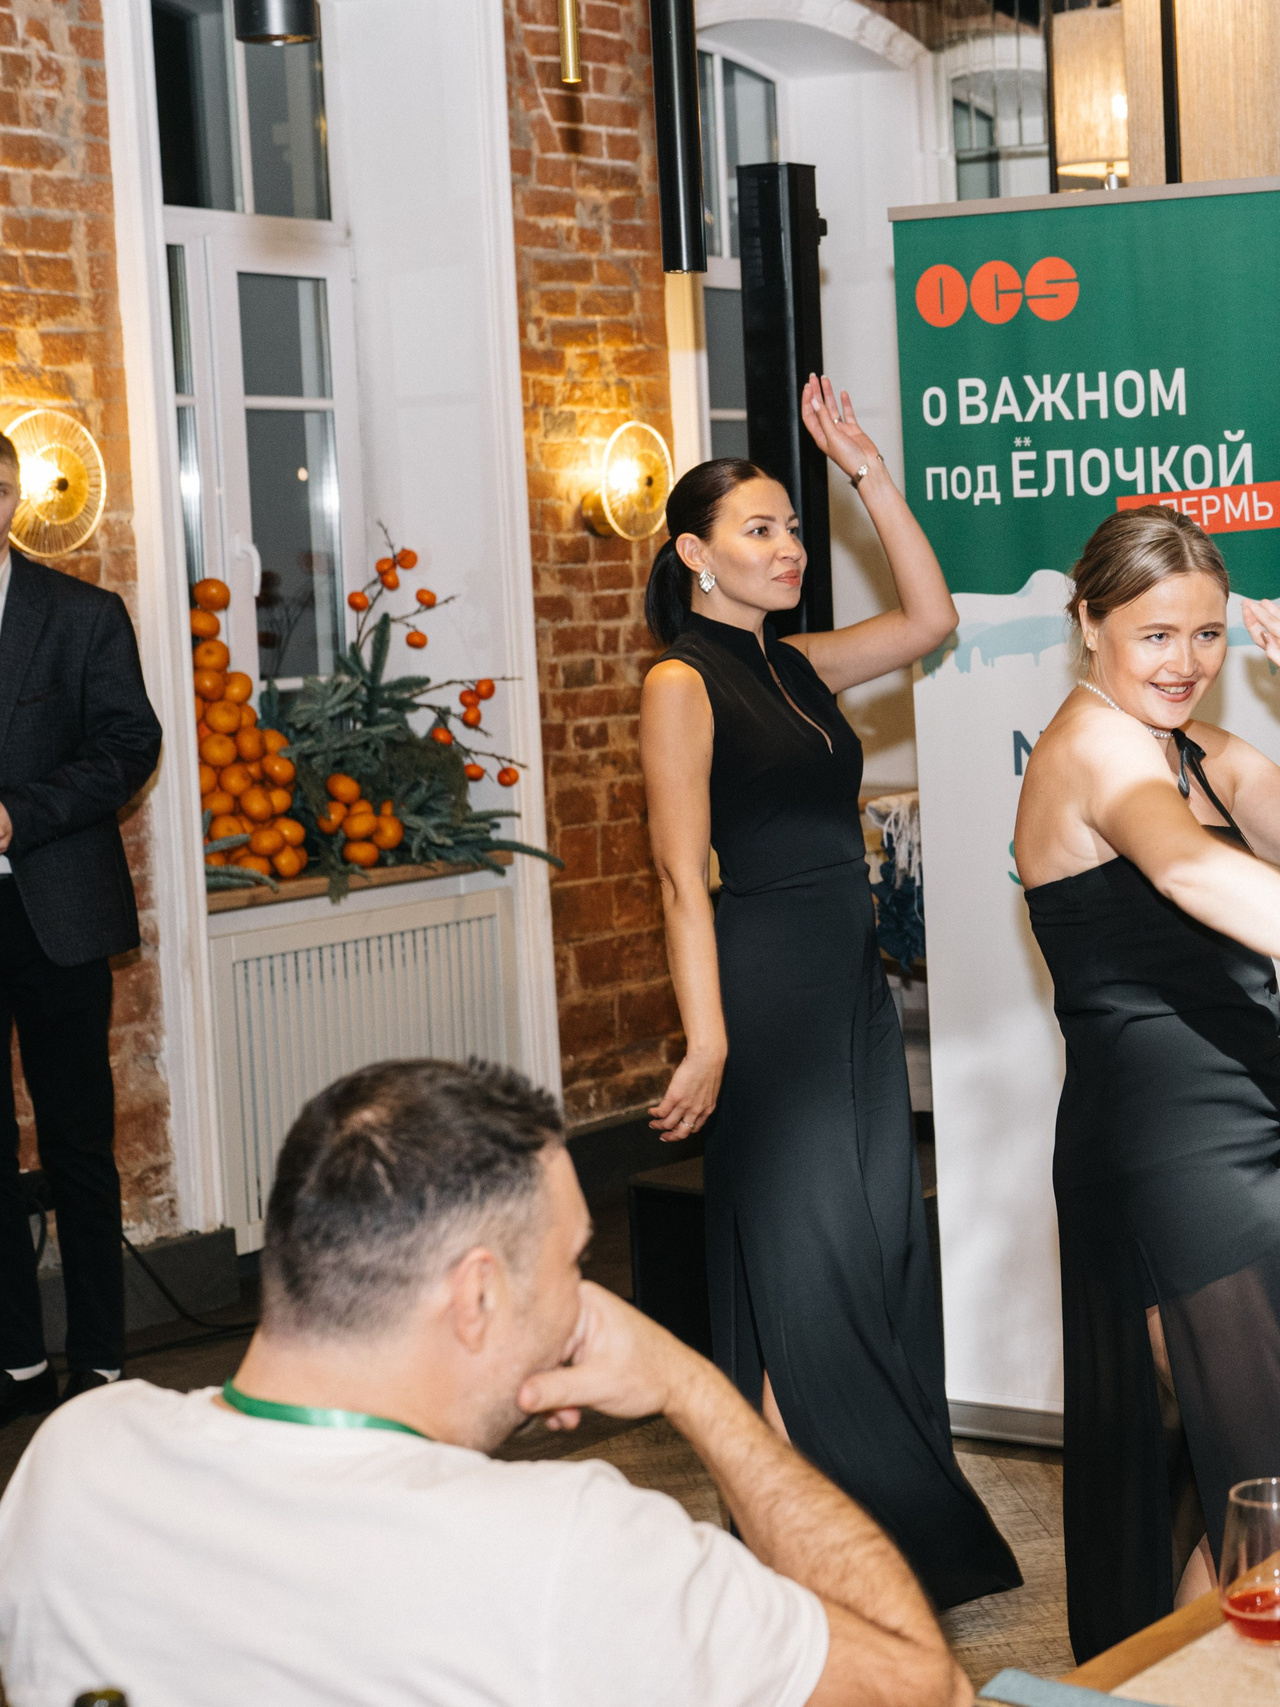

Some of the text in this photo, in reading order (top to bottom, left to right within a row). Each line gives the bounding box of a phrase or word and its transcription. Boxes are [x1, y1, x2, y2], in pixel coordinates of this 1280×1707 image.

[915, 256, 1080, 328] OCS
[957, 367, 1188, 425] ВАЖНОМ
[925, 429, 1255, 506] под ЁЛОЧКОЙ
